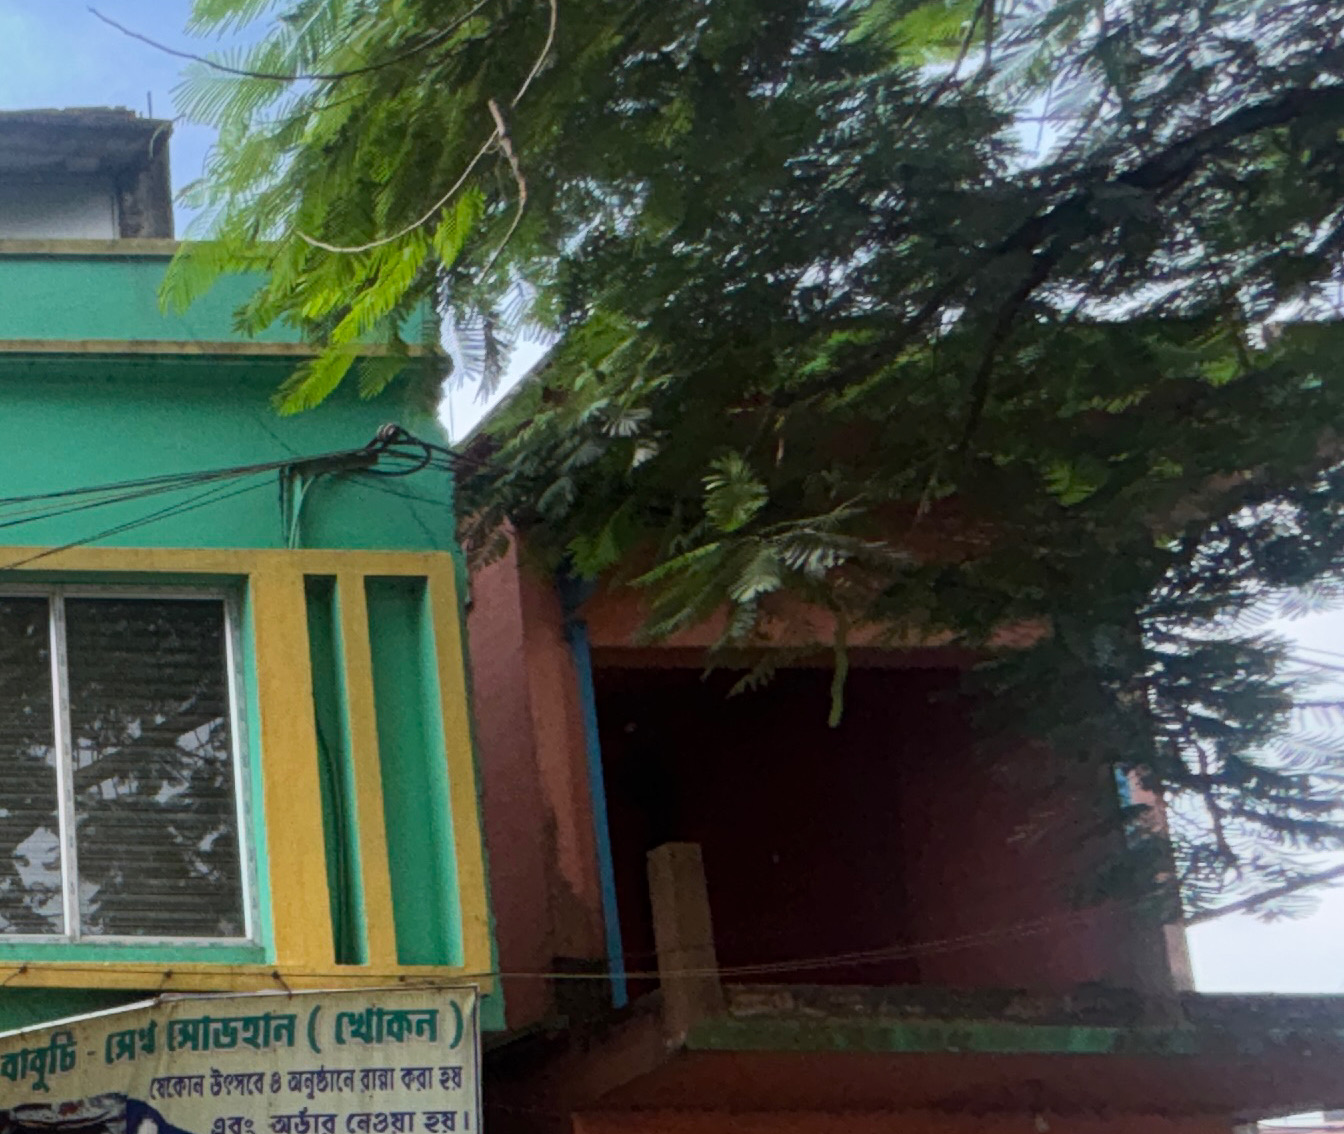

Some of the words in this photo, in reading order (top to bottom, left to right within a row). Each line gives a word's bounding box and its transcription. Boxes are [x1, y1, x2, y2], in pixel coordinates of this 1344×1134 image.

[334, 1007, 440, 1046] খোকন
[209, 1066, 266, 1097] উৎসবে
[287, 1065, 356, 1100] অনুষ্ঠানে
[359, 1067, 396, 1094] রান্না
[401, 1066, 434, 1092] করা
[438, 1065, 463, 1092] হয়
